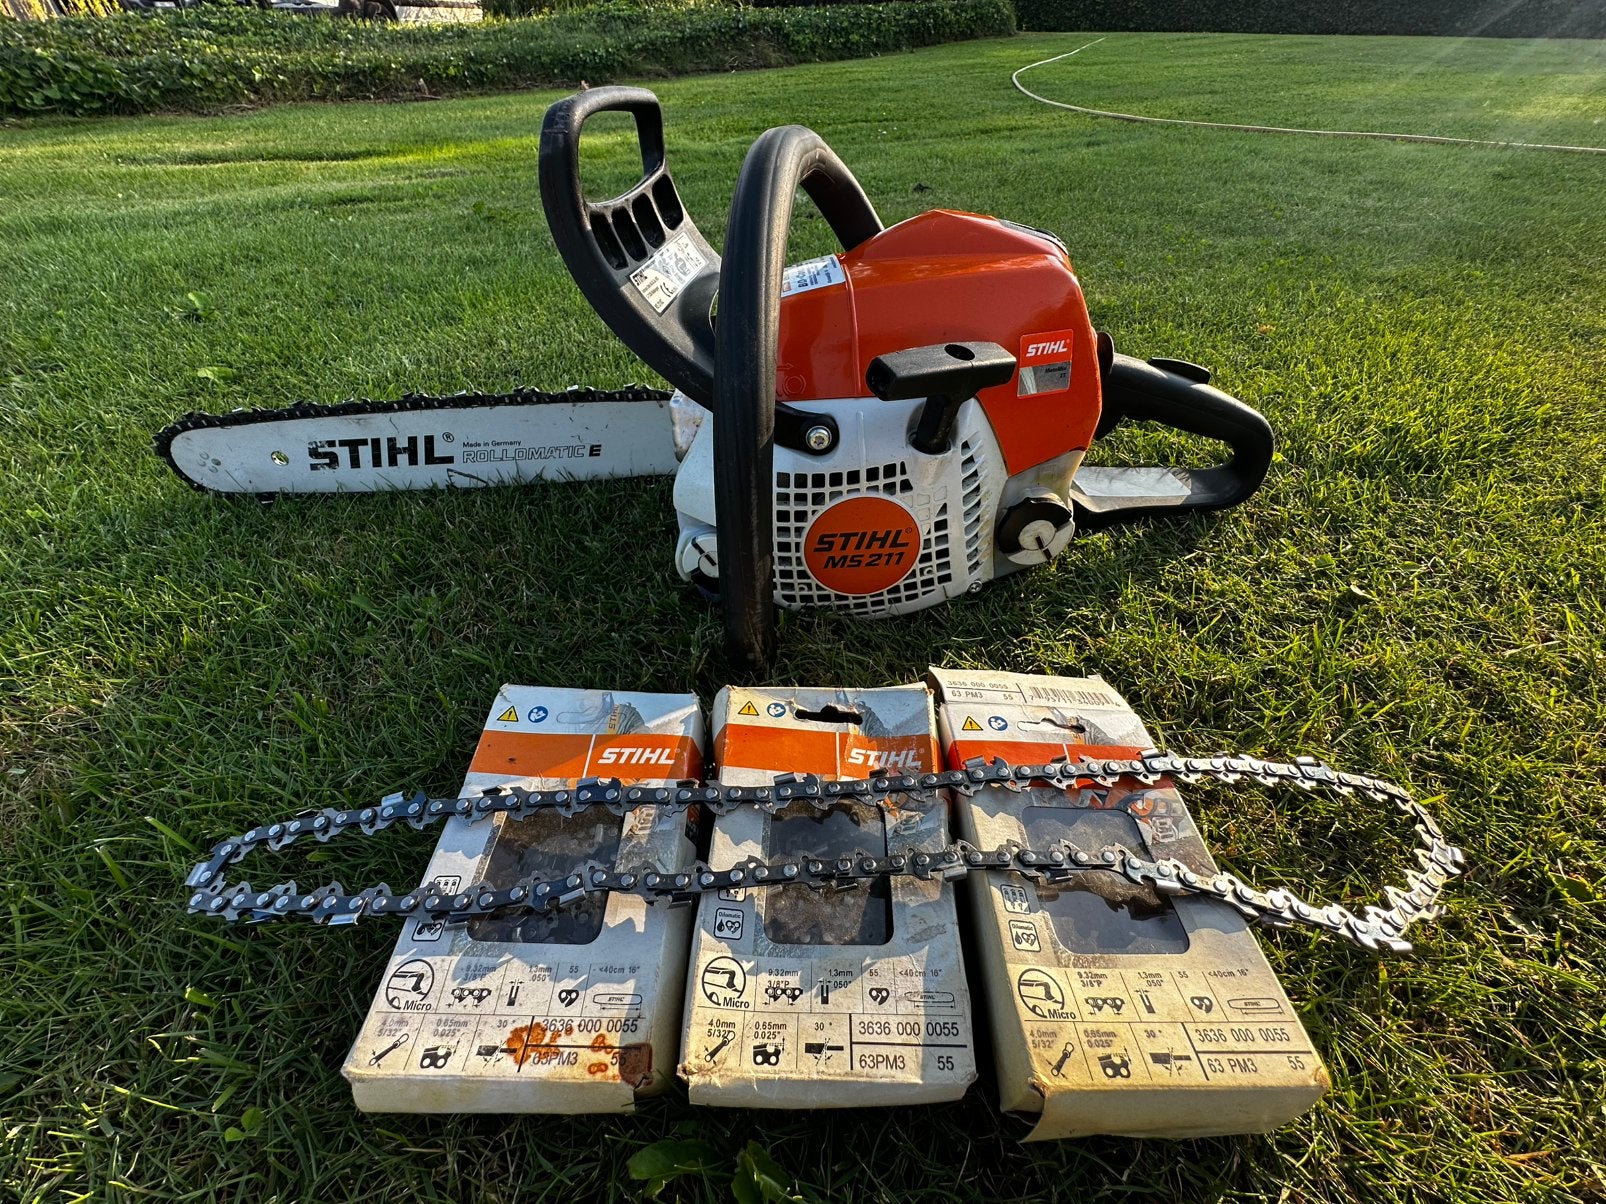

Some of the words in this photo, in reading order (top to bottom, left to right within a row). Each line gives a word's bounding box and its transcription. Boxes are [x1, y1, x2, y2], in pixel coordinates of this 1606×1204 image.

[1026, 340, 1068, 357] STIHL
[463, 445, 585, 463] ROLLOMATIC
[588, 444, 602, 457] E
[598, 748, 676, 765] STIHL
[848, 749, 922, 768] STIHL
[402, 1000, 432, 1011] Micro
[722, 997, 750, 1008] Micro
[1048, 1008, 1076, 1020] Micro
[542, 1019, 573, 1032] 3636
[578, 1019, 602, 1033] 000
[606, 1019, 638, 1033] 0055
[859, 1021, 891, 1035] 3636
[897, 1022, 920, 1036] 000
[926, 1022, 959, 1036] 0055
[1195, 1029, 1227, 1042] 3636
[1231, 1028, 1255, 1042] 000
[1259, 1028, 1290, 1042] 0055
[532, 1052, 578, 1065] 63PM3
[610, 1052, 626, 1066] 55
[860, 1054, 906, 1070] 63PM3
[938, 1056, 954, 1070] 55
[1207, 1058, 1224, 1073] 63
[1227, 1058, 1258, 1073] PM3
[1287, 1056, 1305, 1070] 55
